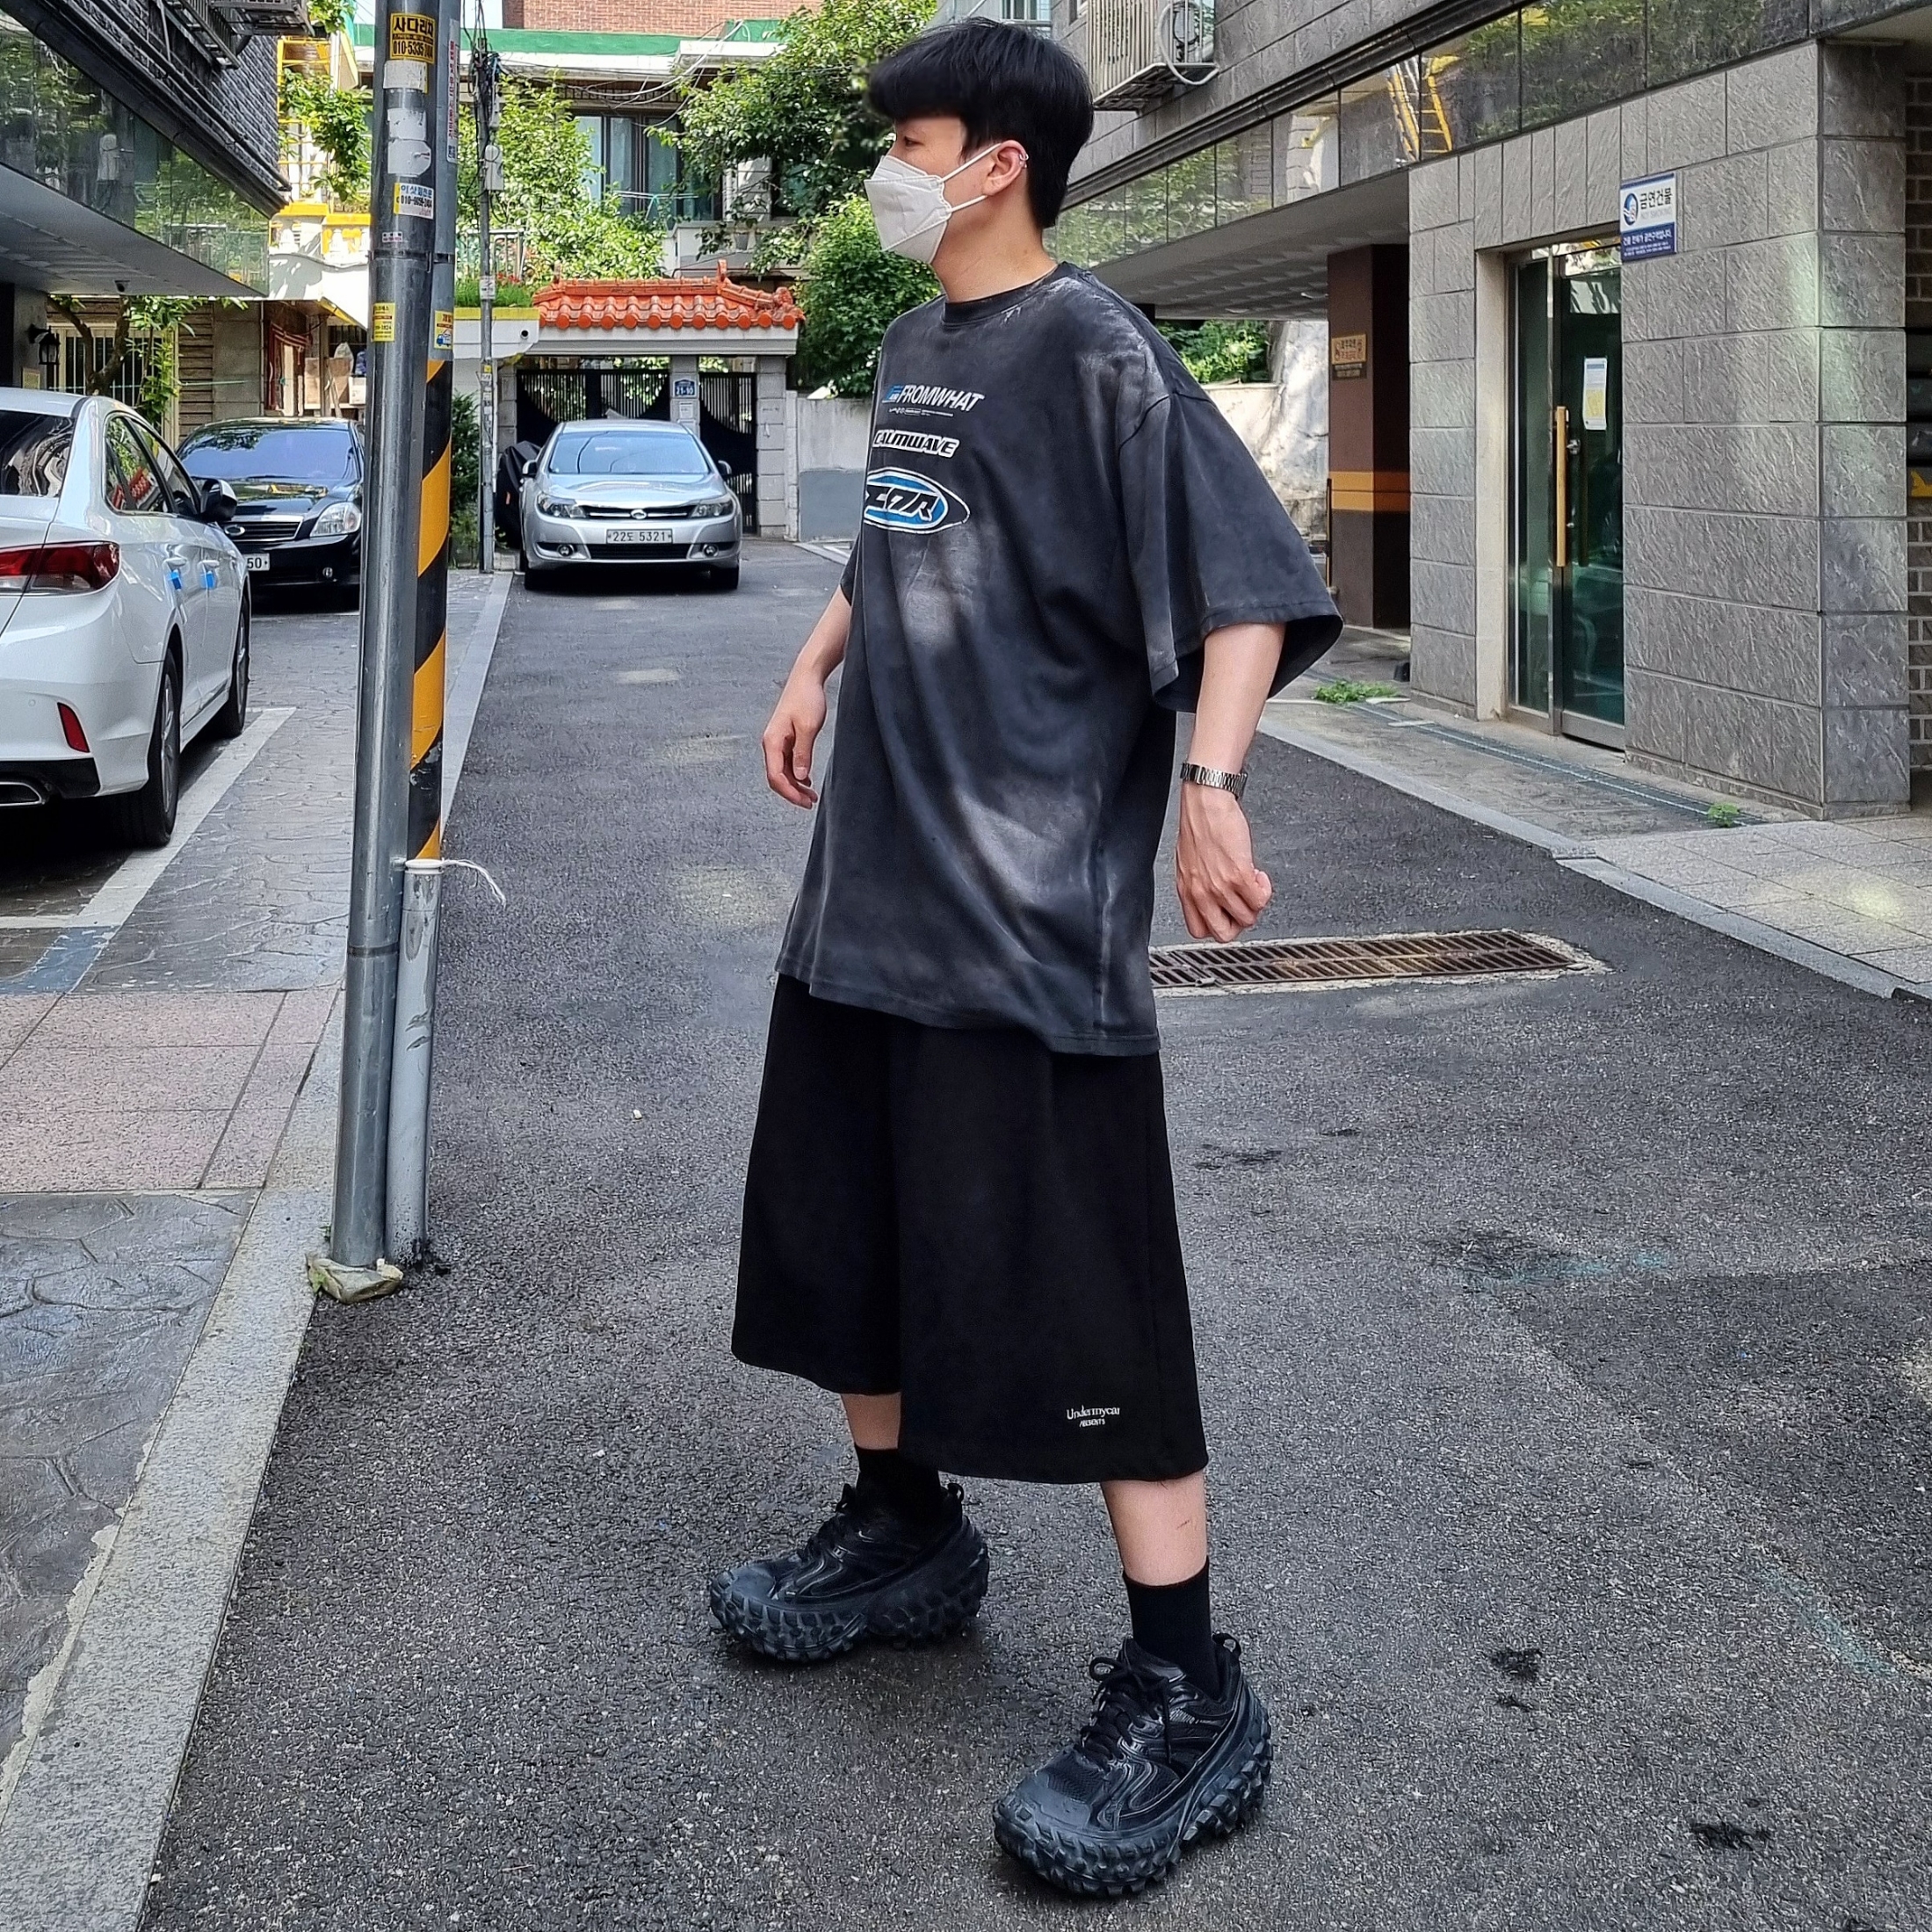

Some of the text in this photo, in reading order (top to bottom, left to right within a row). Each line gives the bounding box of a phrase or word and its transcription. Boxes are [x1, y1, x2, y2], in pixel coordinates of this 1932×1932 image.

[1639, 187, 1672, 210] 금연건물
[896, 385, 985, 411] FROMWHAT
[639, 532, 666, 542] 5321
